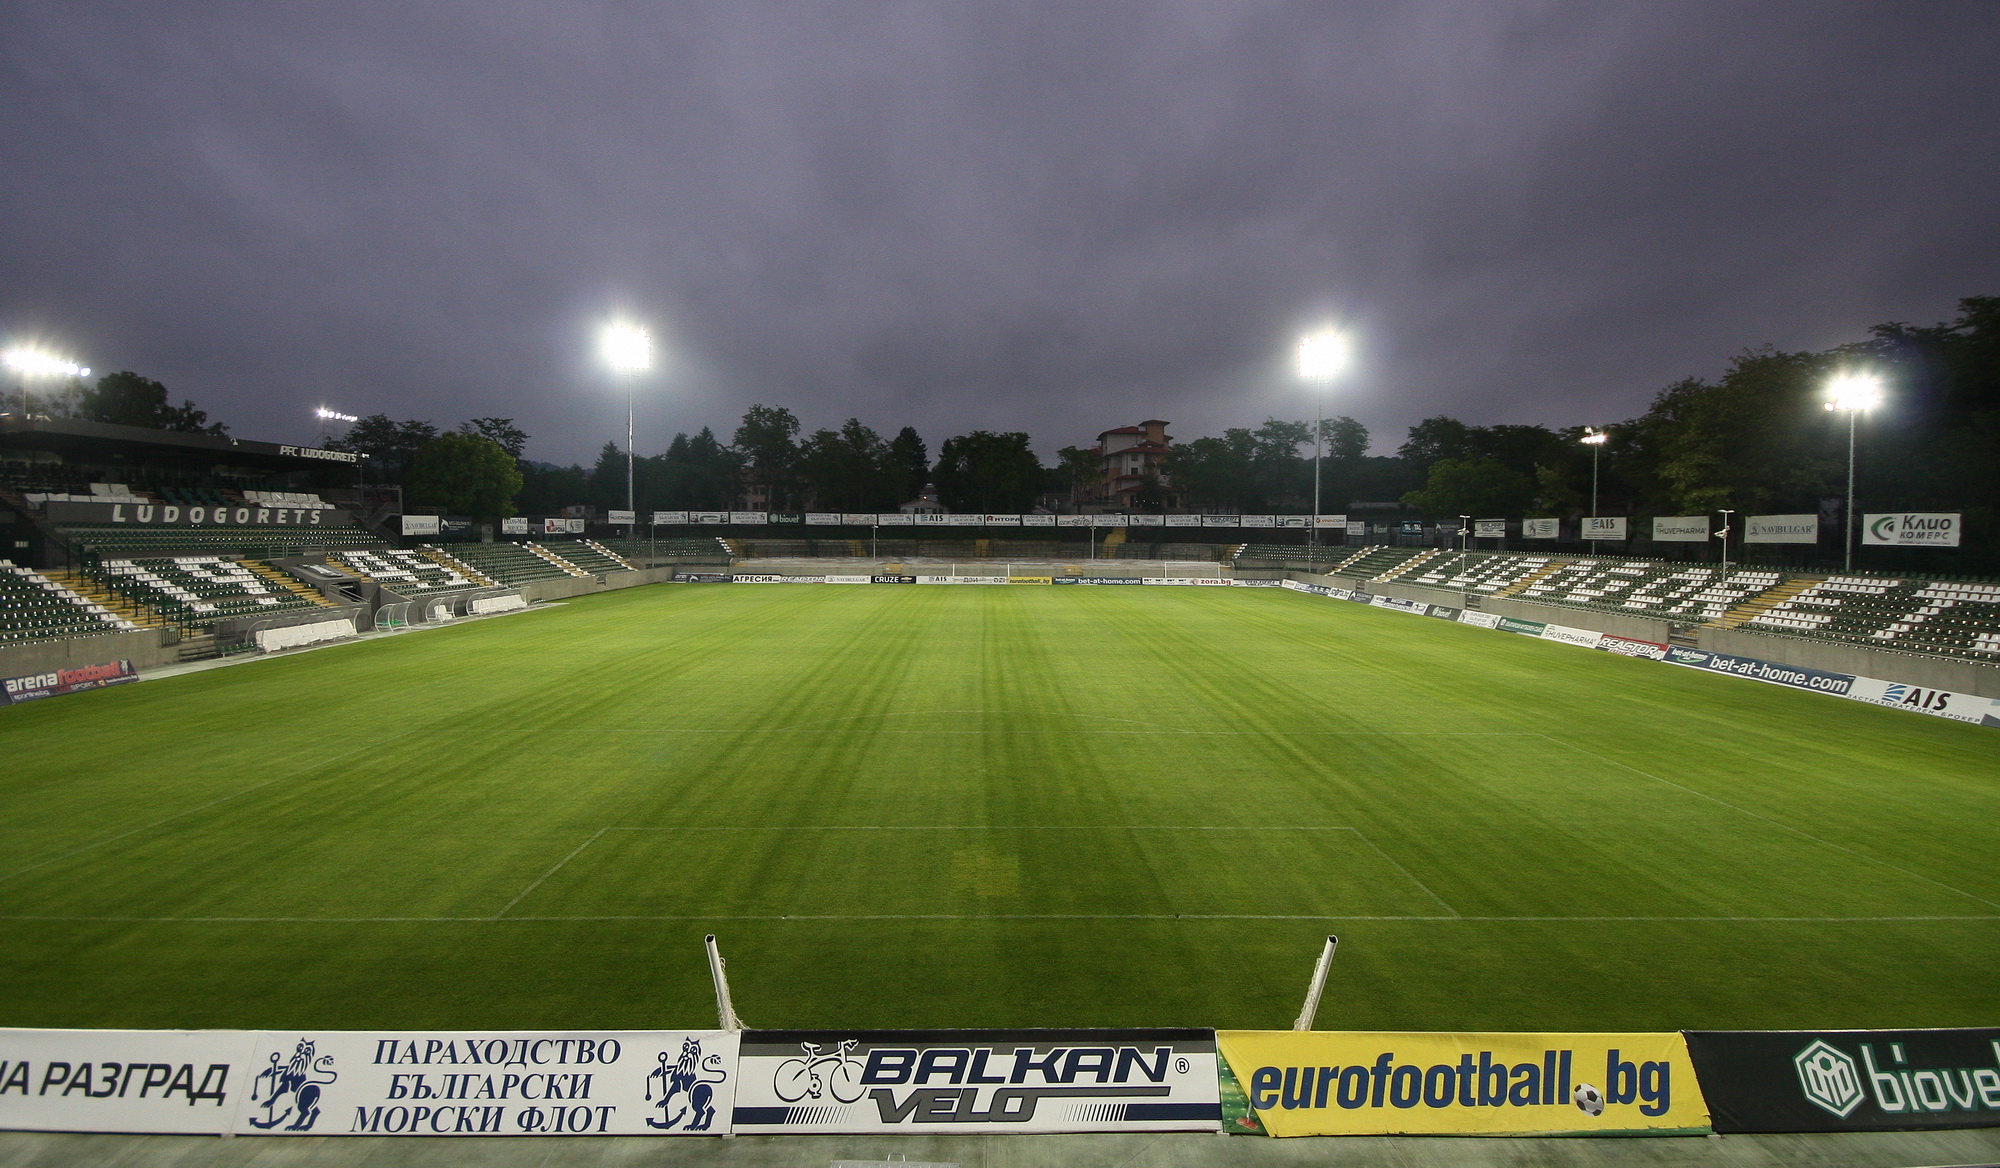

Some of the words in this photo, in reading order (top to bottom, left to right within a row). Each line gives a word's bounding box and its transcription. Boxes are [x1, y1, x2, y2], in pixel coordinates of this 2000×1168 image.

[280, 445, 298, 456] PFC
[301, 448, 357, 462] LUDOGORETS
[112, 504, 320, 524] LUDOGORETS
[780, 514, 799, 523] biovet
[929, 514, 944, 522] AIS
[1600, 518, 1615, 529] AIS
[1902, 515, 1952, 530] Клио
[1761, 525, 1812, 534] NAVIBULGAR
[1900, 531, 1950, 540] КОМЕРС
[1549, 629, 1596, 645] HUVEPHARMA
[1599, 637, 1660, 655] REACTOR
[1709, 655, 1849, 693] bet-at-home.com
[1848, 694, 1935, 715] ЗАСТРАХОВАТЕЛЕН
[1940, 712, 1981, 723] БРОКЕР
[1902, 688, 1952, 711] AIS
[371, 1039, 622, 1071] ПАРАХОДСТВО
[860, 1046, 1175, 1085] BALKAN
[39, 1061, 231, 1107] РАЗГРАД
[1860, 1038, 2000, 1113] biove
[385, 1073, 595, 1100] БЪЛГАРСКИ
[868, 1087, 1038, 1124] VELO
[349, 1105, 506, 1133] МОРСКИ
[516, 1105, 617, 1133] ФЛОТ
